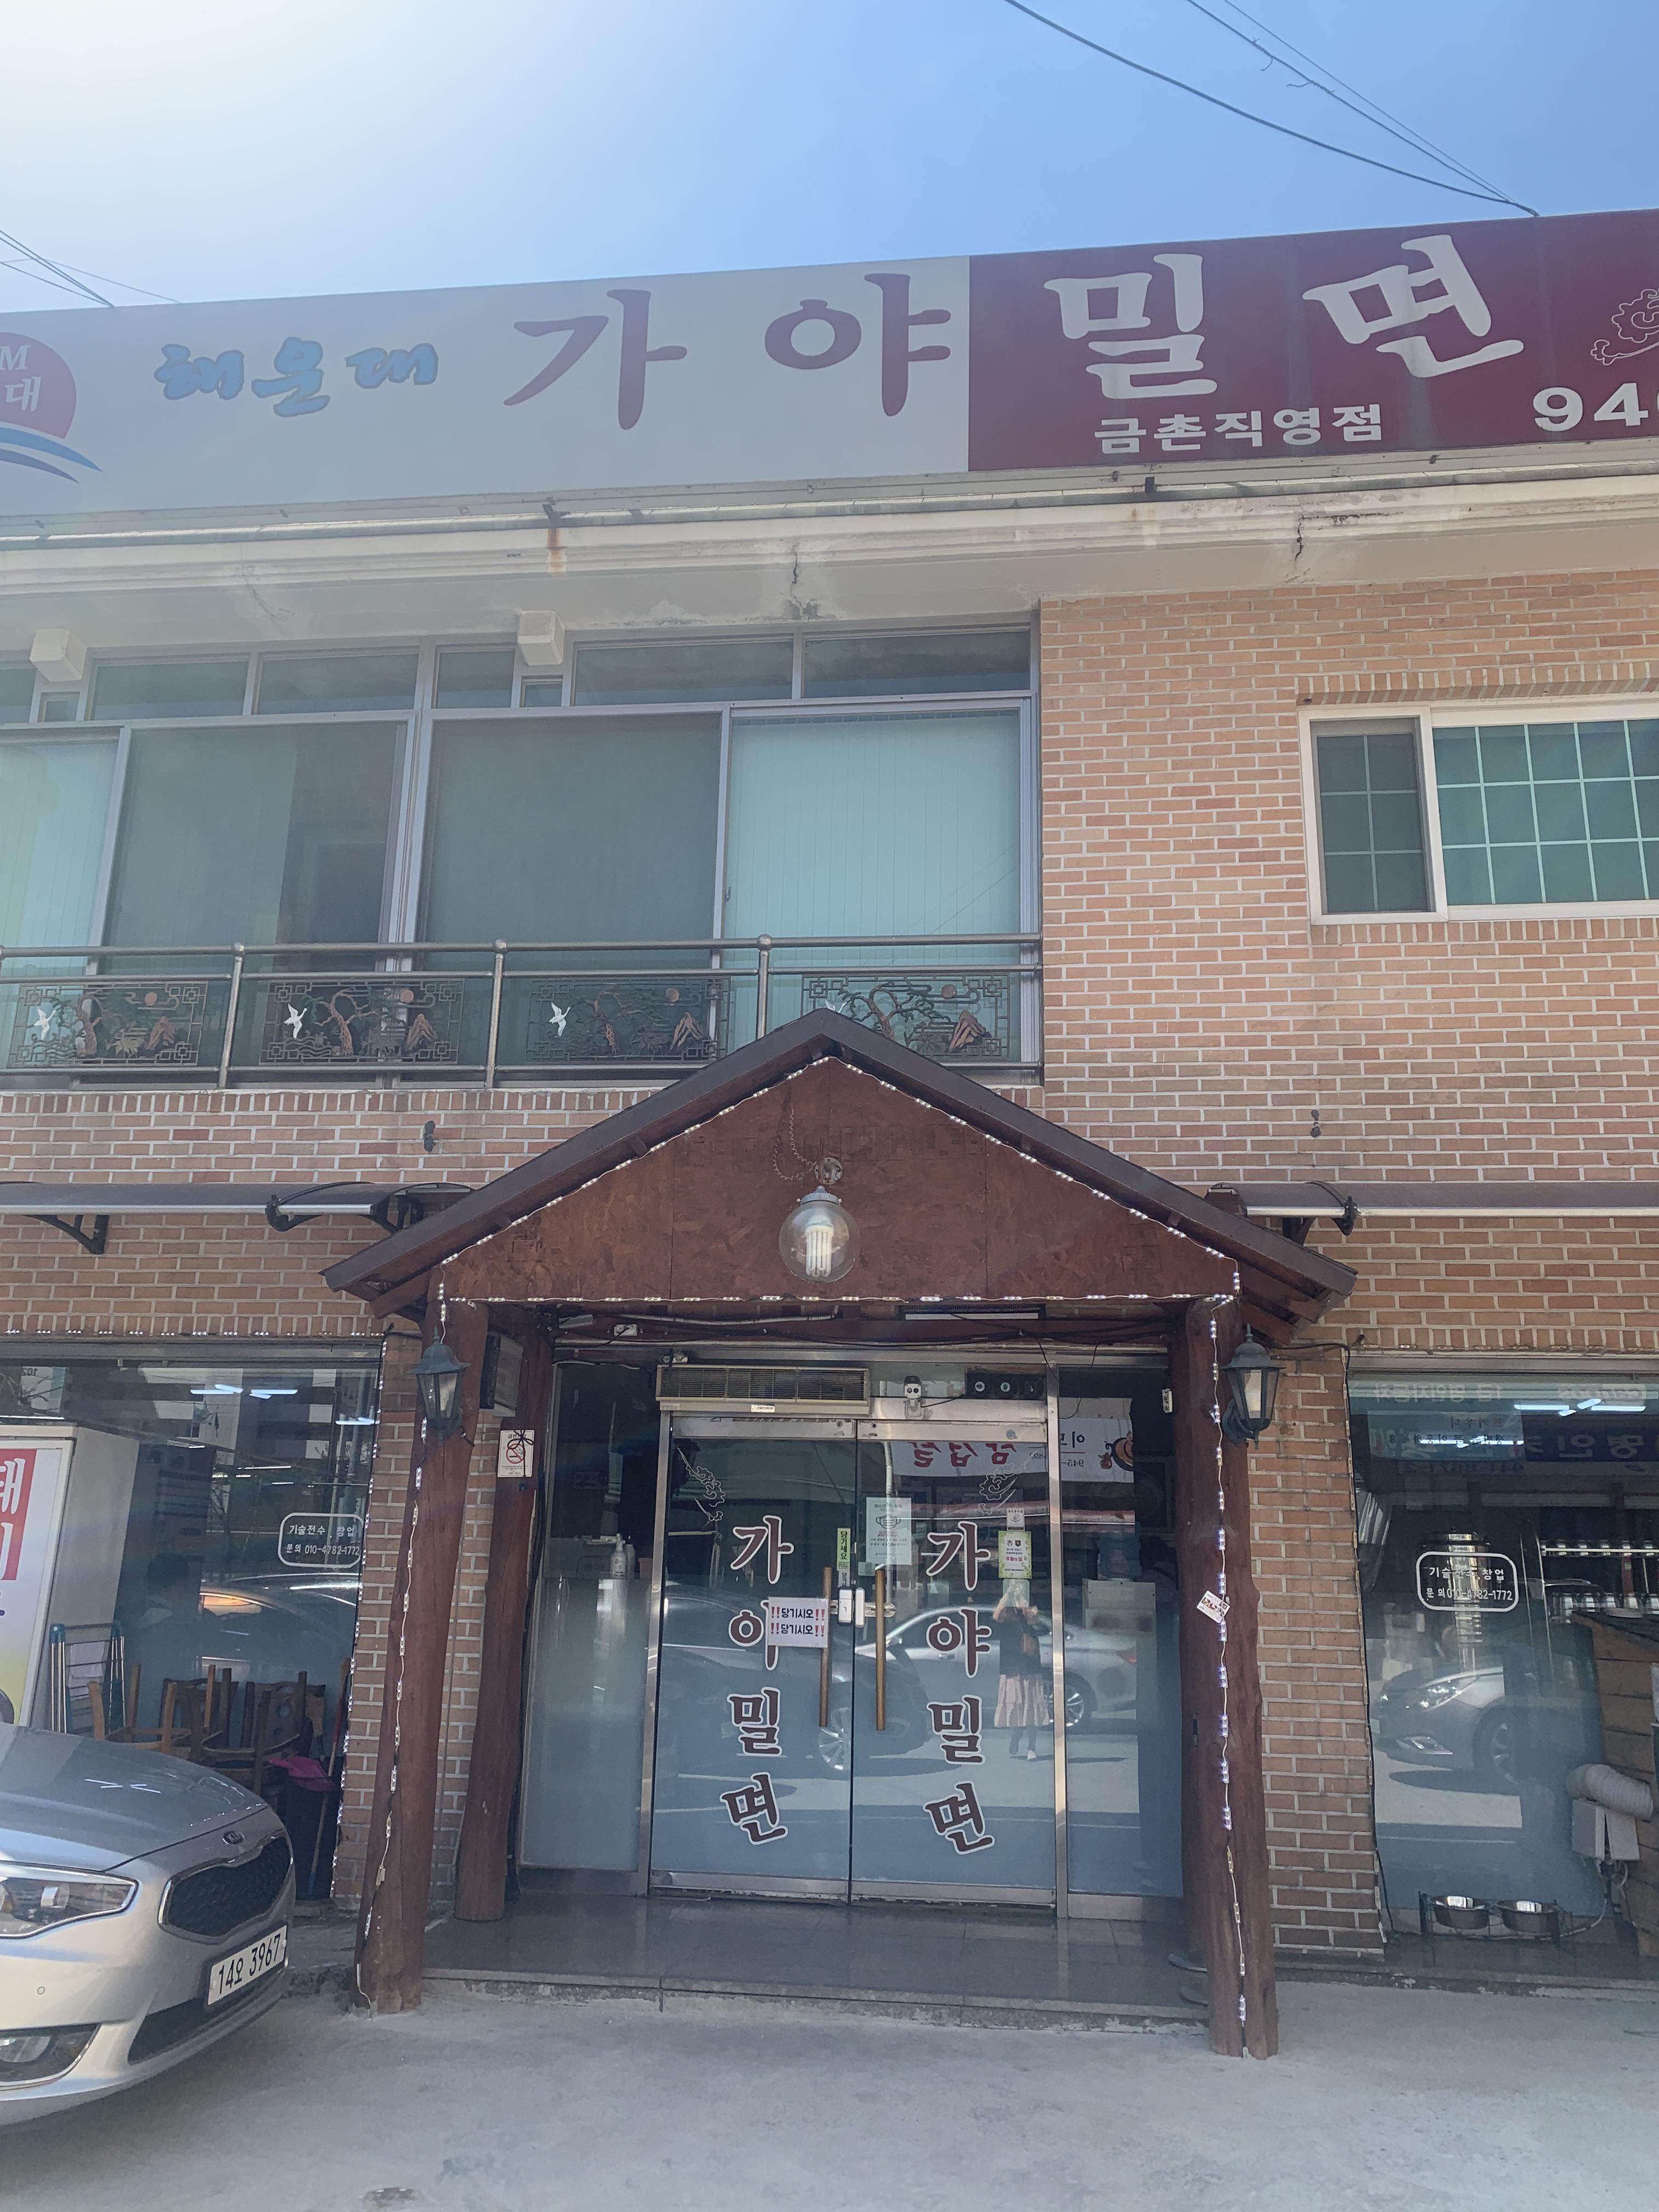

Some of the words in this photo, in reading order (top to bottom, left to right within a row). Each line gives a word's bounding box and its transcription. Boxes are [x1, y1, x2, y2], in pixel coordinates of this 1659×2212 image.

[154, 337, 438, 417] 해운대
[1094, 404, 1382, 454] 금촌직영점
[1533, 382, 1659, 432] 94
[304, 1545, 360, 1555] 010-4782-1772
[250, 1933, 281, 1977] 3967
